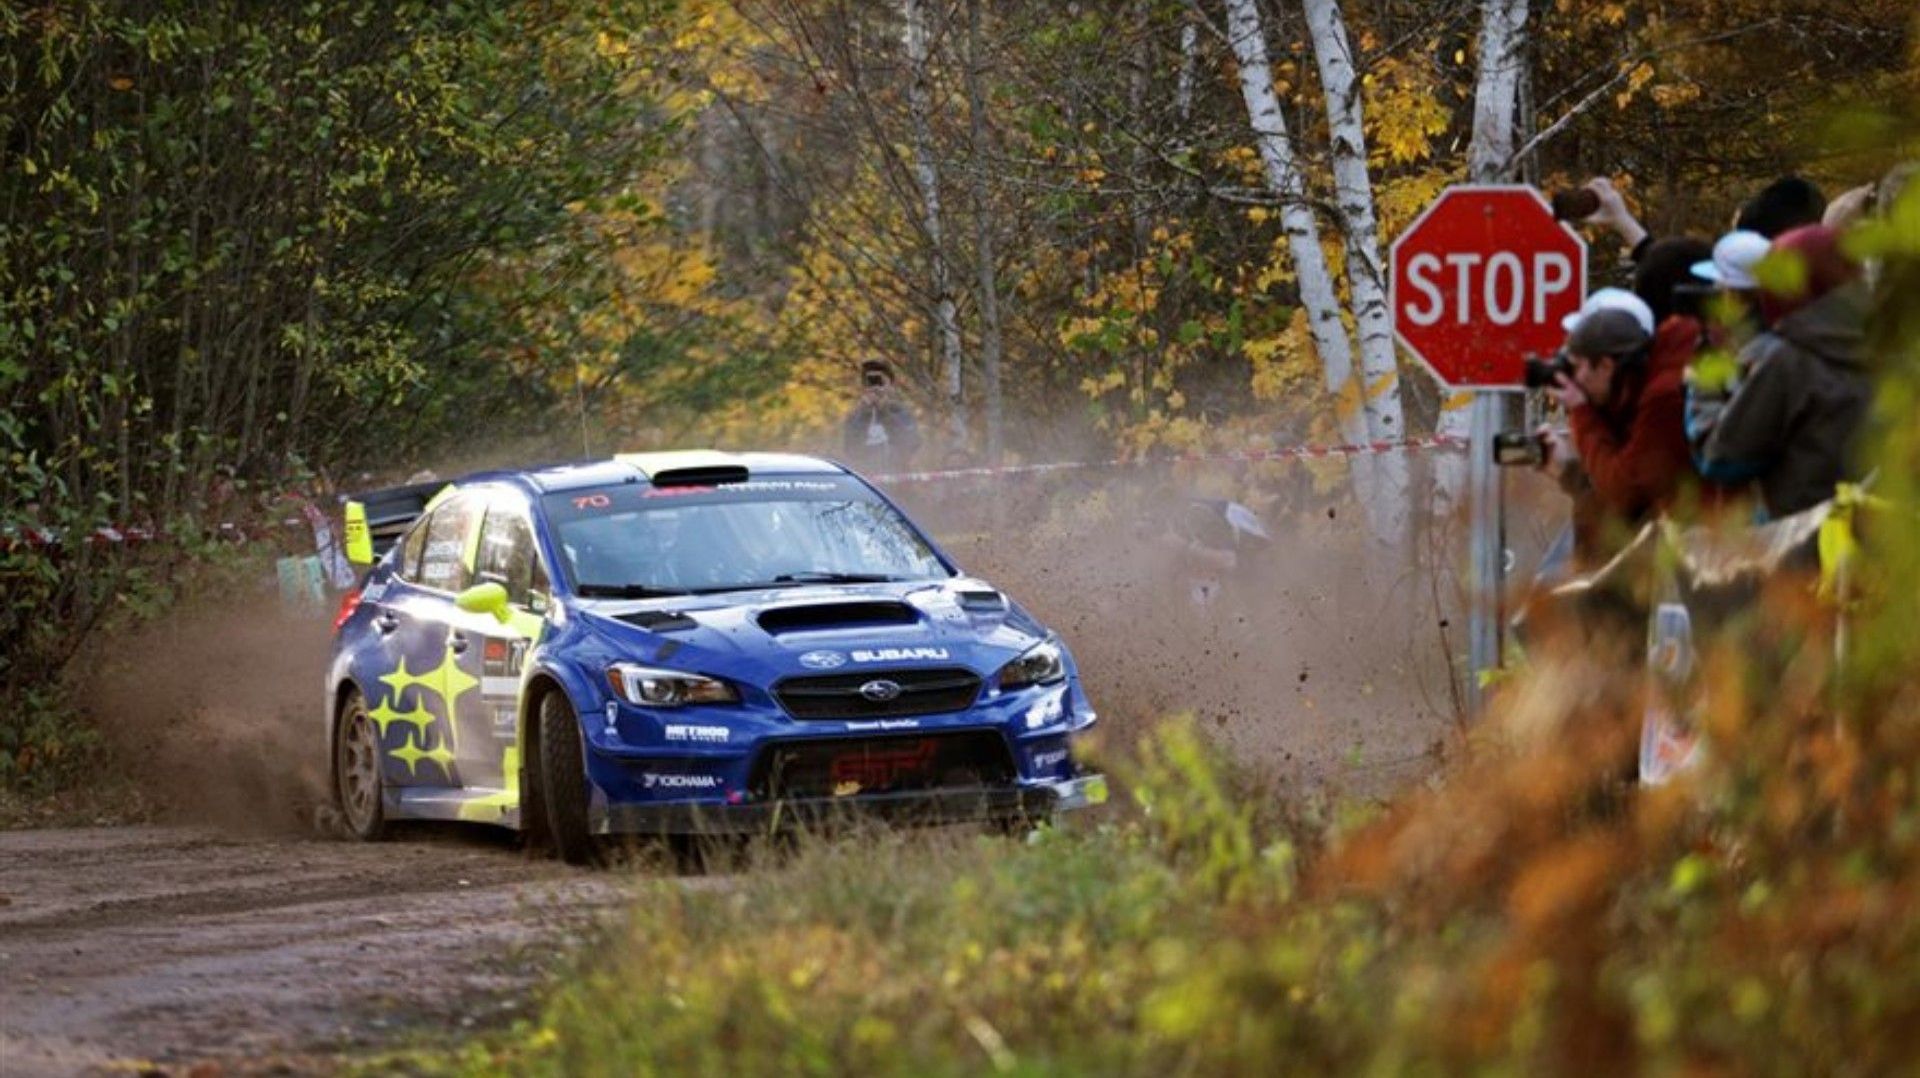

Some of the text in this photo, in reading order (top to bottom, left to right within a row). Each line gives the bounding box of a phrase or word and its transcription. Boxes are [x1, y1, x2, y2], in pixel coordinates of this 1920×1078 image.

[1405, 252, 1573, 326] STOP
[851, 648, 949, 662] SUBARU
[659, 774, 717, 788] YOKOHAMA
